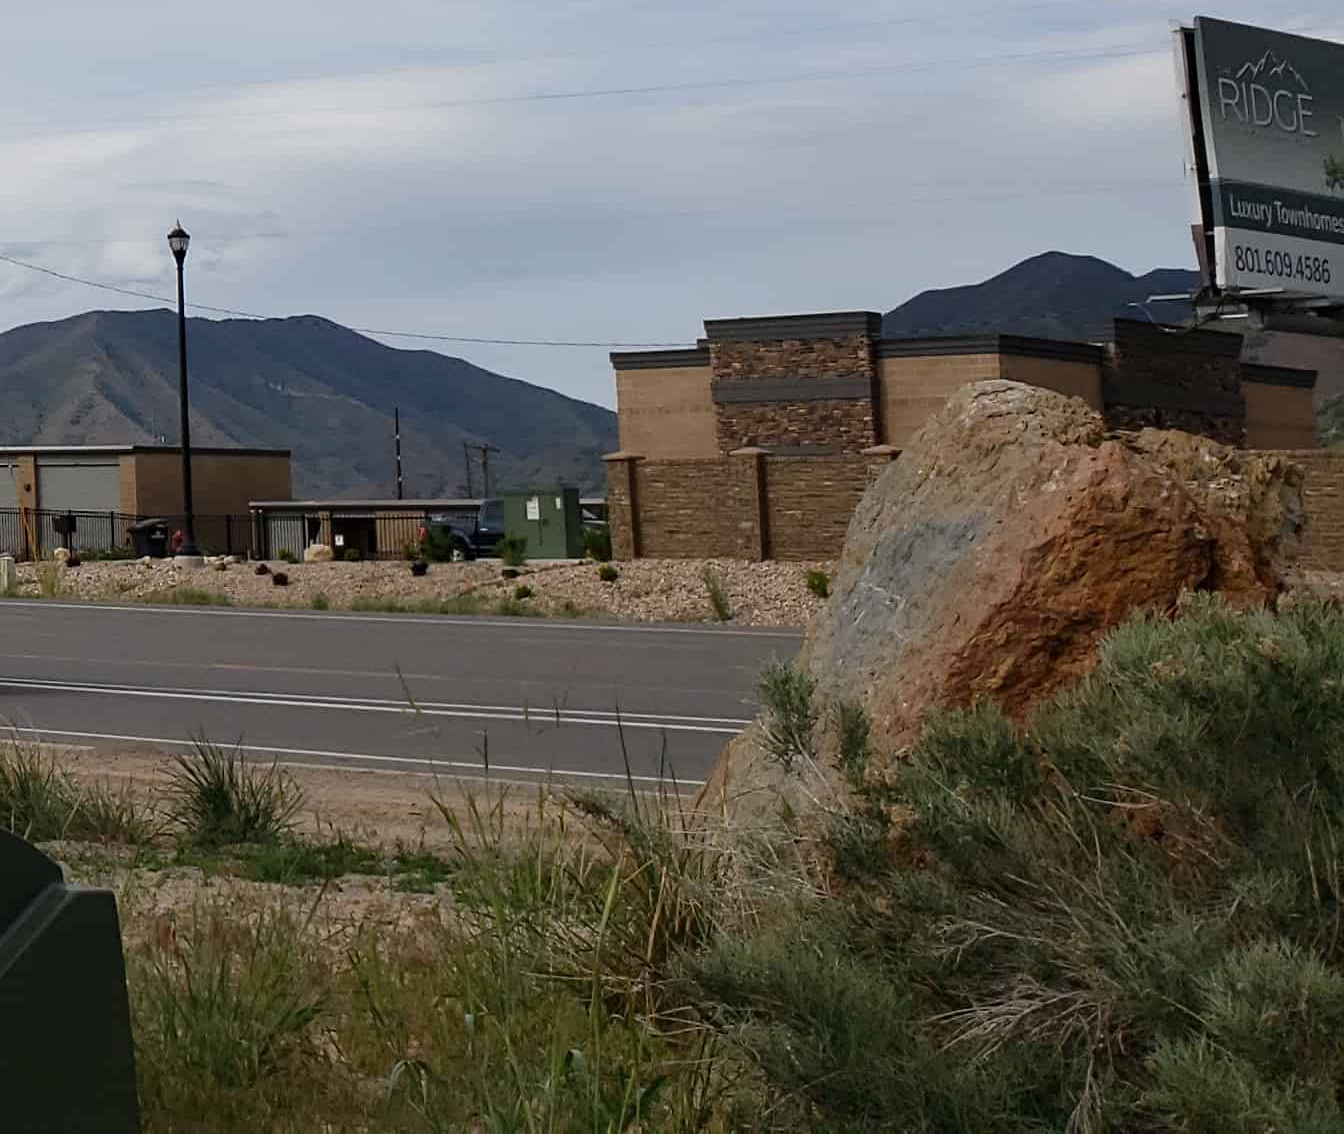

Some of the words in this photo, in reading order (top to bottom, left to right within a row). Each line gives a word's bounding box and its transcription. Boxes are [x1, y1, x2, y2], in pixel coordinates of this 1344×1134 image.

[1217, 77, 1319, 137] RIDGE
[1230, 194, 1272, 227] Luxury
[1273, 201, 1344, 233] Townhomes
[1235, 245, 1331, 284] 801.609.4586
